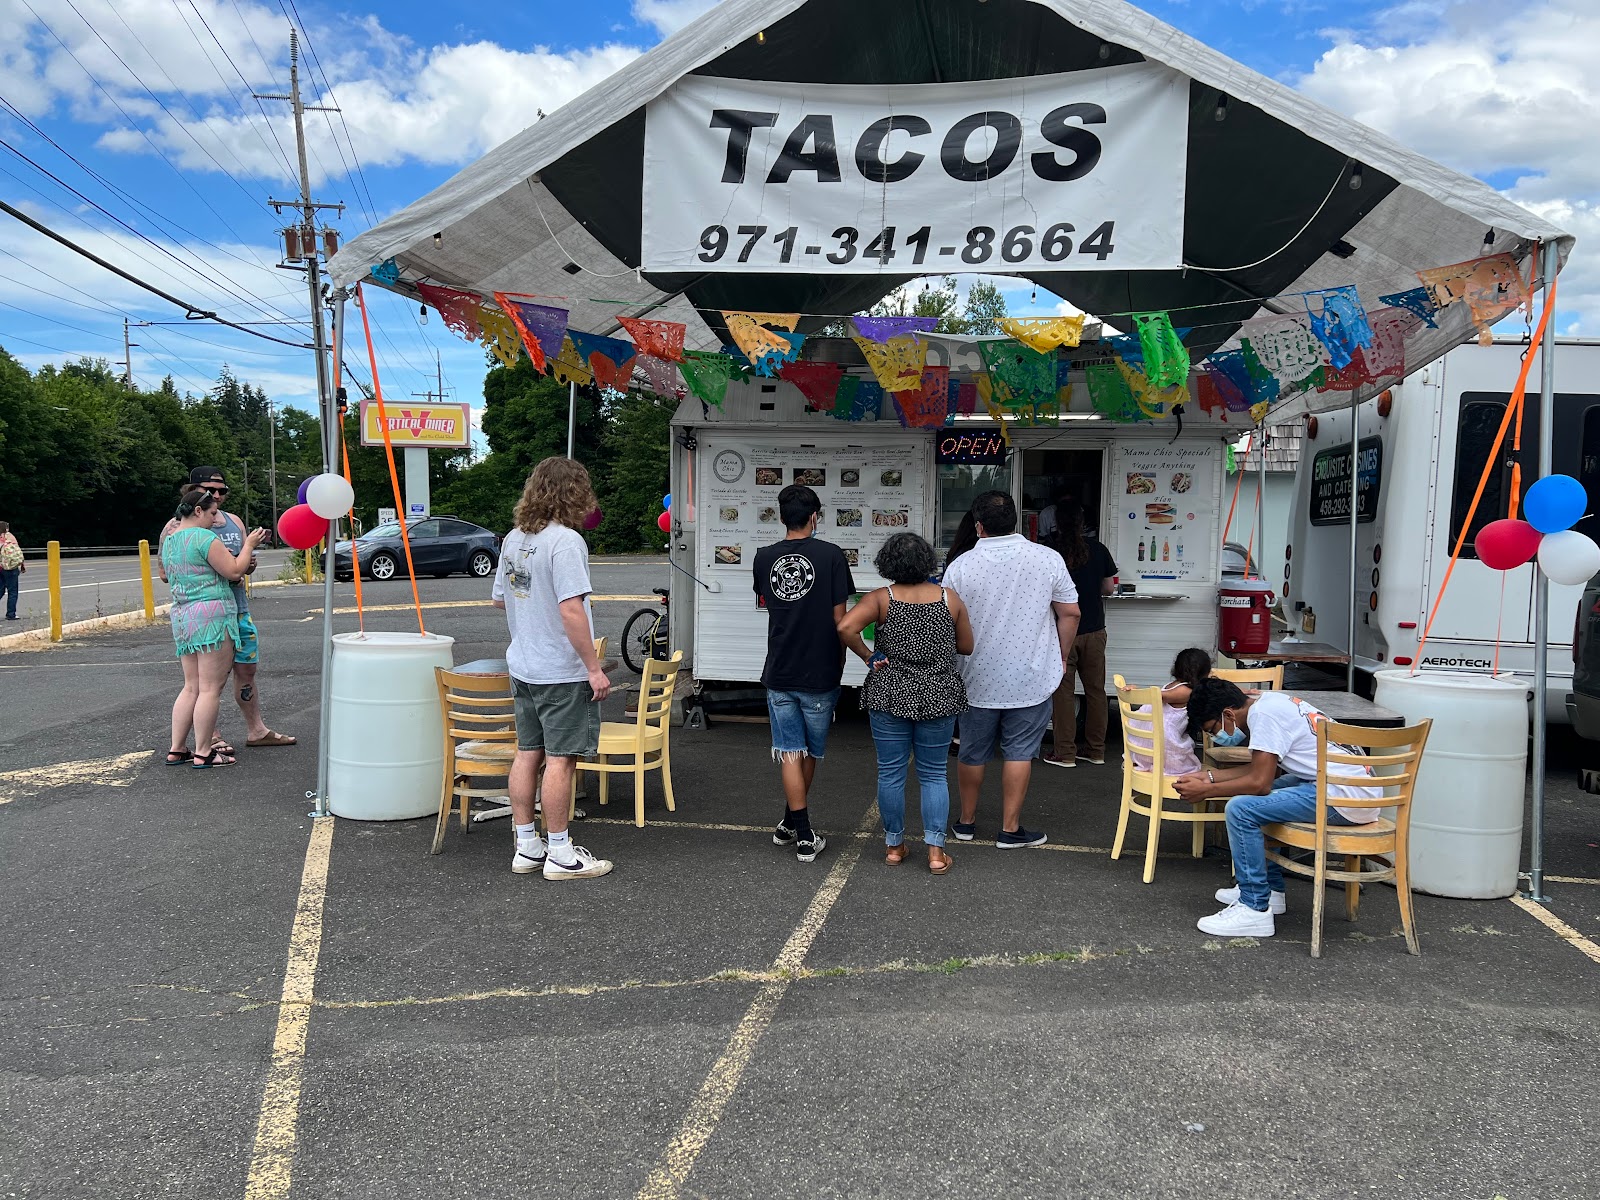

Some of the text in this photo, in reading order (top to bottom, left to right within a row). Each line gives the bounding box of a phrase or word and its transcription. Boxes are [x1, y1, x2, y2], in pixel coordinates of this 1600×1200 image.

[709, 102, 1107, 184] TACOS
[697, 220, 1115, 265] 971-341-8664
[376, 417, 455, 434] VRTICAL DINER
[940, 438, 1002, 455] OPEN
[1153, 447, 1173, 457] Chio
[1176, 447, 1212, 459] Specials
[1132, 462, 1196, 471] Veggie Anything
[1315, 448, 1378, 481] EXQUISITE CSINES
[1319, 483, 1332, 498] AND
[1220, 596, 1250, 605] Horchata
[1421, 657, 1491, 668] AEROTECH
